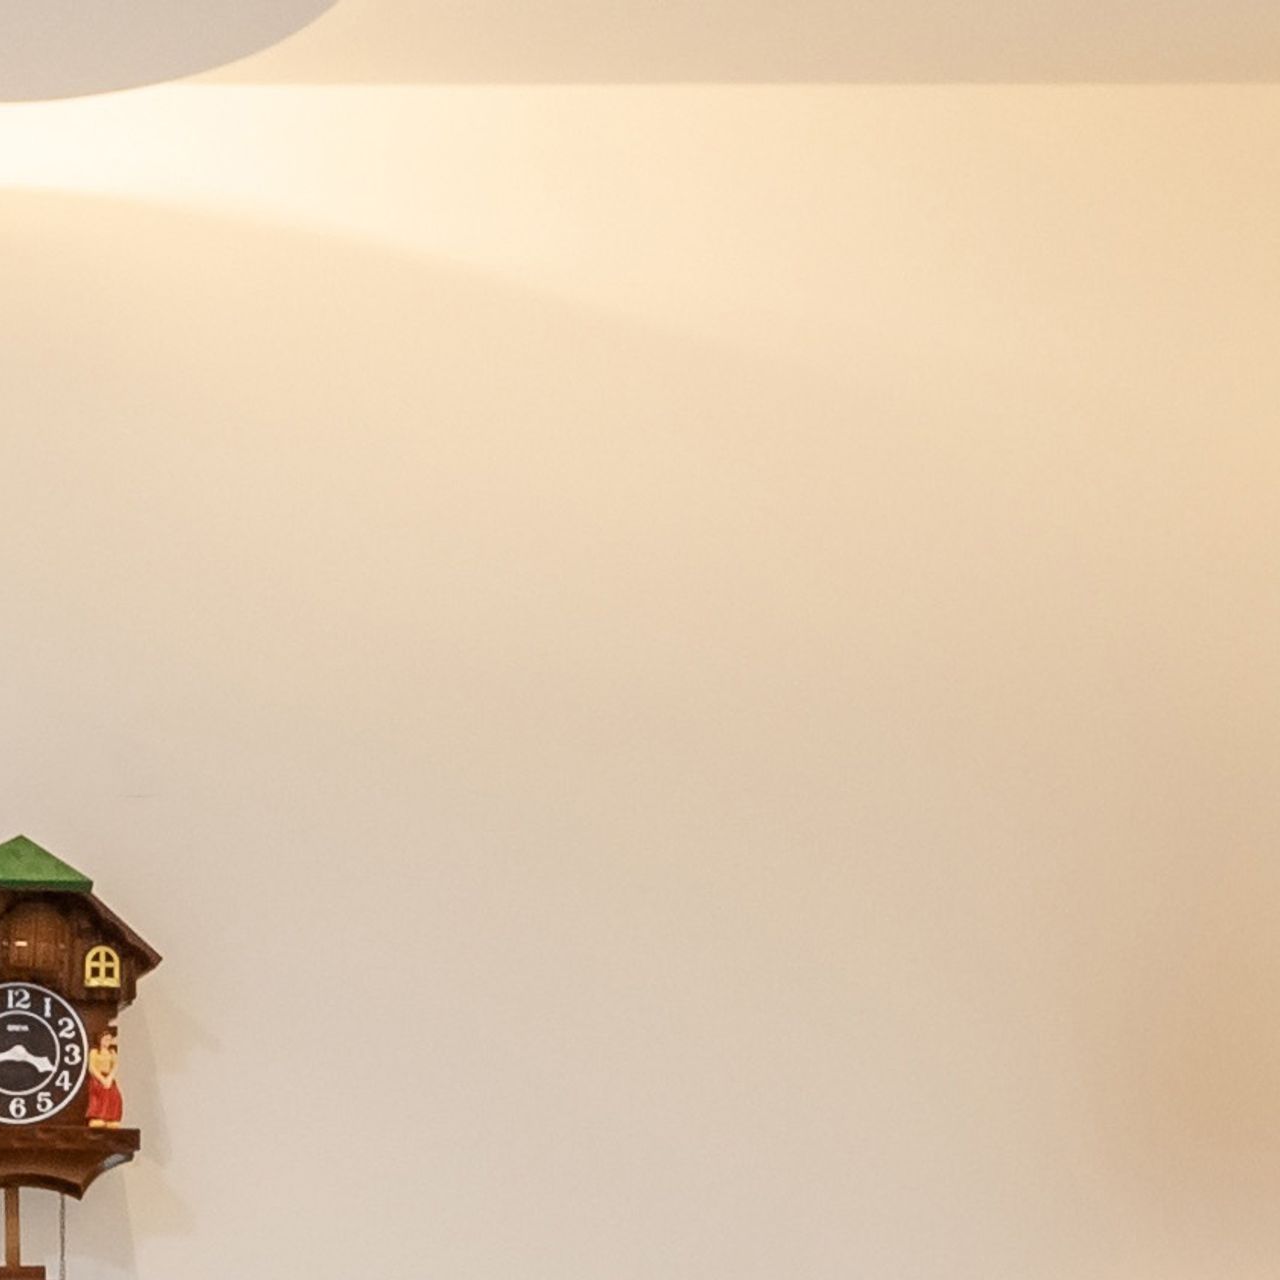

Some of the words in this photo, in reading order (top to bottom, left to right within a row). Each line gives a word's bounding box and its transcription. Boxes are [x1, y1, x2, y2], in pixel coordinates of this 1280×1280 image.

[7, 989, 32, 1009] 12
[44, 997, 52, 1018] 1
[58, 1017, 76, 1039] 2
[64, 1044, 82, 1065] 3
[55, 1070, 72, 1091] 4
[9, 1097, 27, 1118] 6
[36, 1092, 54, 1113] 5
